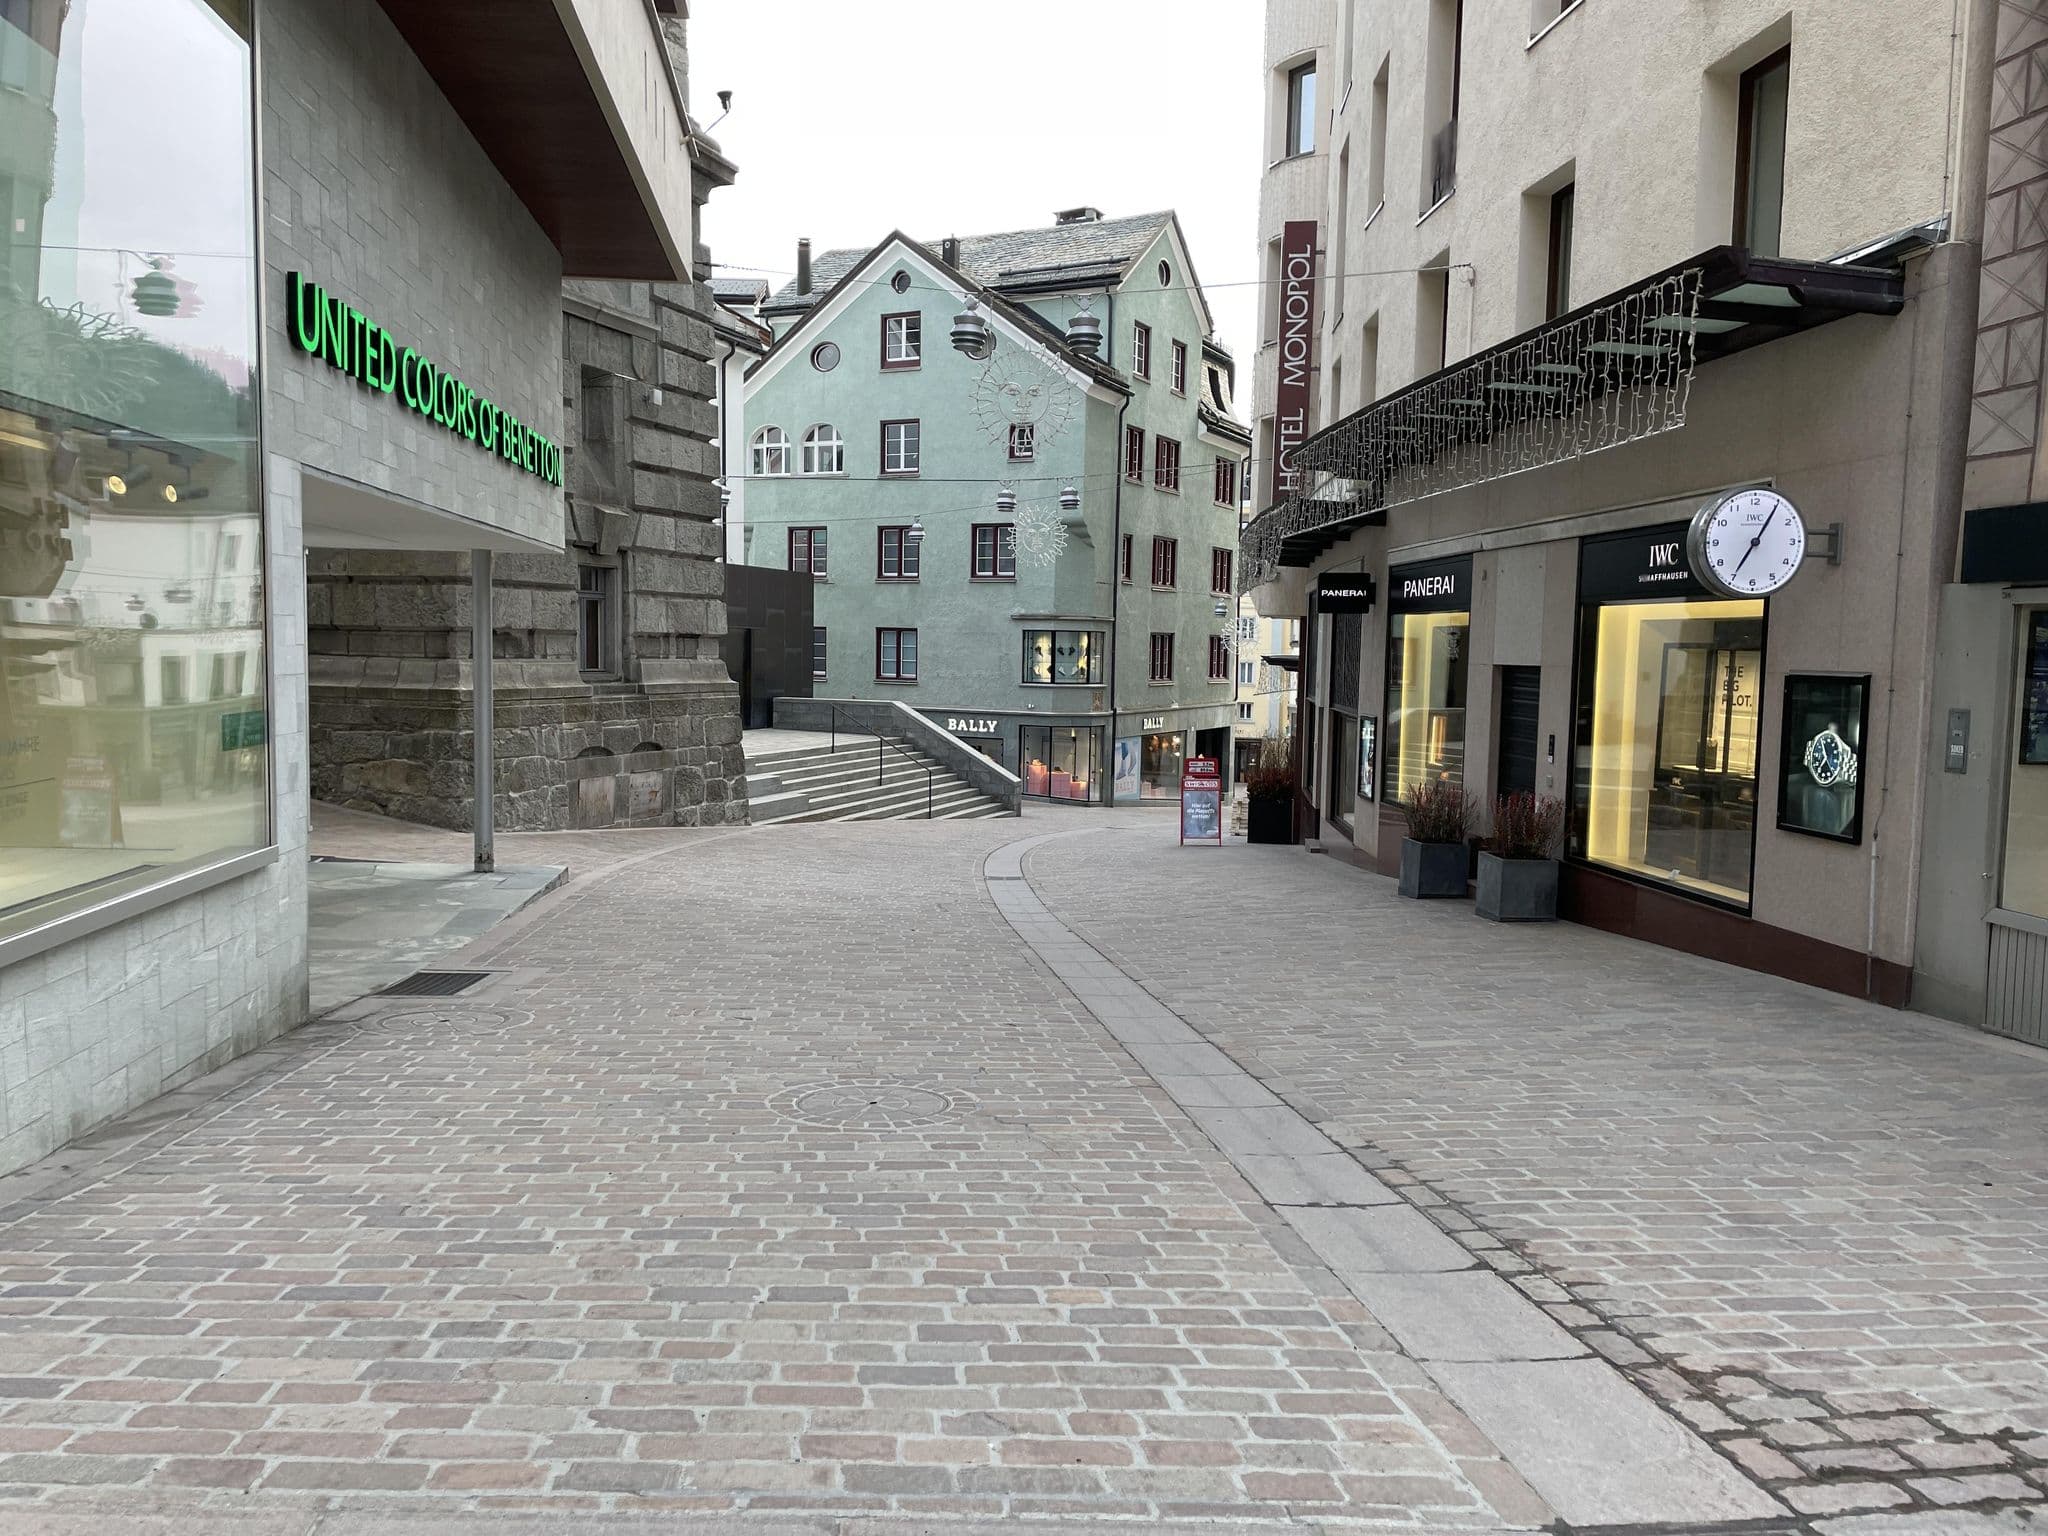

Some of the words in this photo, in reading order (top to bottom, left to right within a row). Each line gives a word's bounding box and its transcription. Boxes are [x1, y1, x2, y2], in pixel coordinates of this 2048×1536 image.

[1283, 244, 1311, 388] MONOPOL
[294, 271, 397, 394] UNITED
[400, 346, 477, 441] COLORS
[479, 398, 499, 453] OF
[1750, 498, 1760, 506] 12
[1730, 504, 1740, 512] 11
[1746, 513, 1764, 522] IWC
[1717, 519, 1728, 527] 10
[1784, 518, 1792, 526] 2
[1712, 539, 1720, 547] 9
[1789, 538, 1796, 546] 3
[1649, 542, 1679, 567] IWC
[1716, 558, 1724, 566] 8
[1769, 572, 1776, 580] 5
[1749, 578, 1756, 586] 6
[1403, 574, 1455, 599] PANERAI
[1321, 589, 1367, 597] PANERAI
[1724, 665, 1744, 678] TE
[1723, 680, 1740, 692] BG
[1721, 694, 1752, 708] POT.
[947, 718, 998, 733] BALLY
[1143, 716, 1164, 730] BALLY
